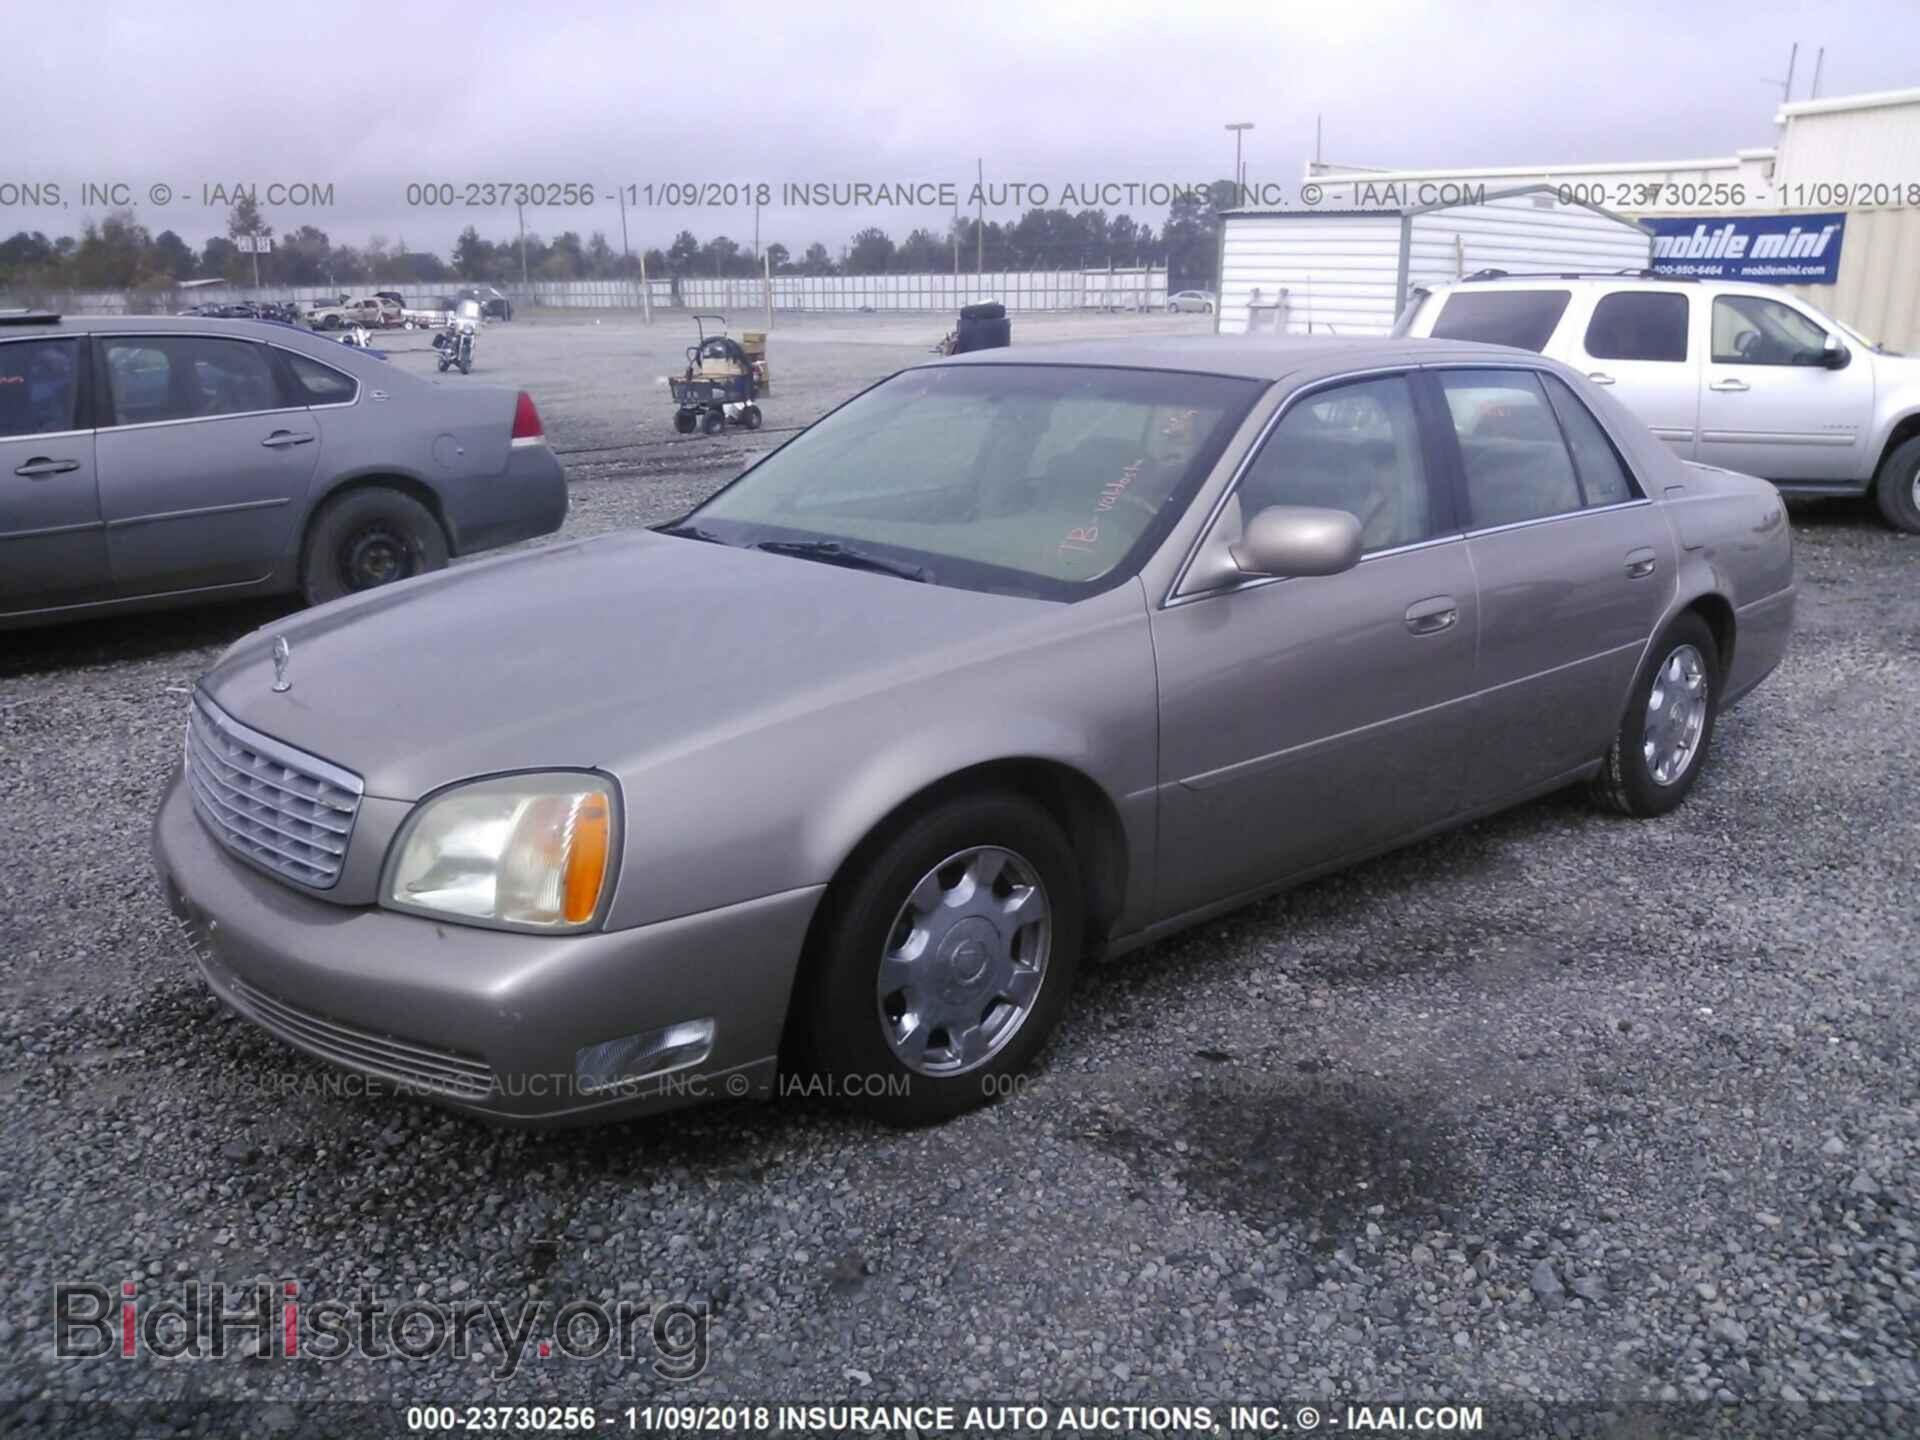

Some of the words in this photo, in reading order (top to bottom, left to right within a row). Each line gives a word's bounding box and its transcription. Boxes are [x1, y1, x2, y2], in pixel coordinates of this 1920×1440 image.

[1653, 224, 1749, 258] mobile
[1750, 227, 1836, 257] mini
[1741, 265, 1826, 275] mobilemini.com
